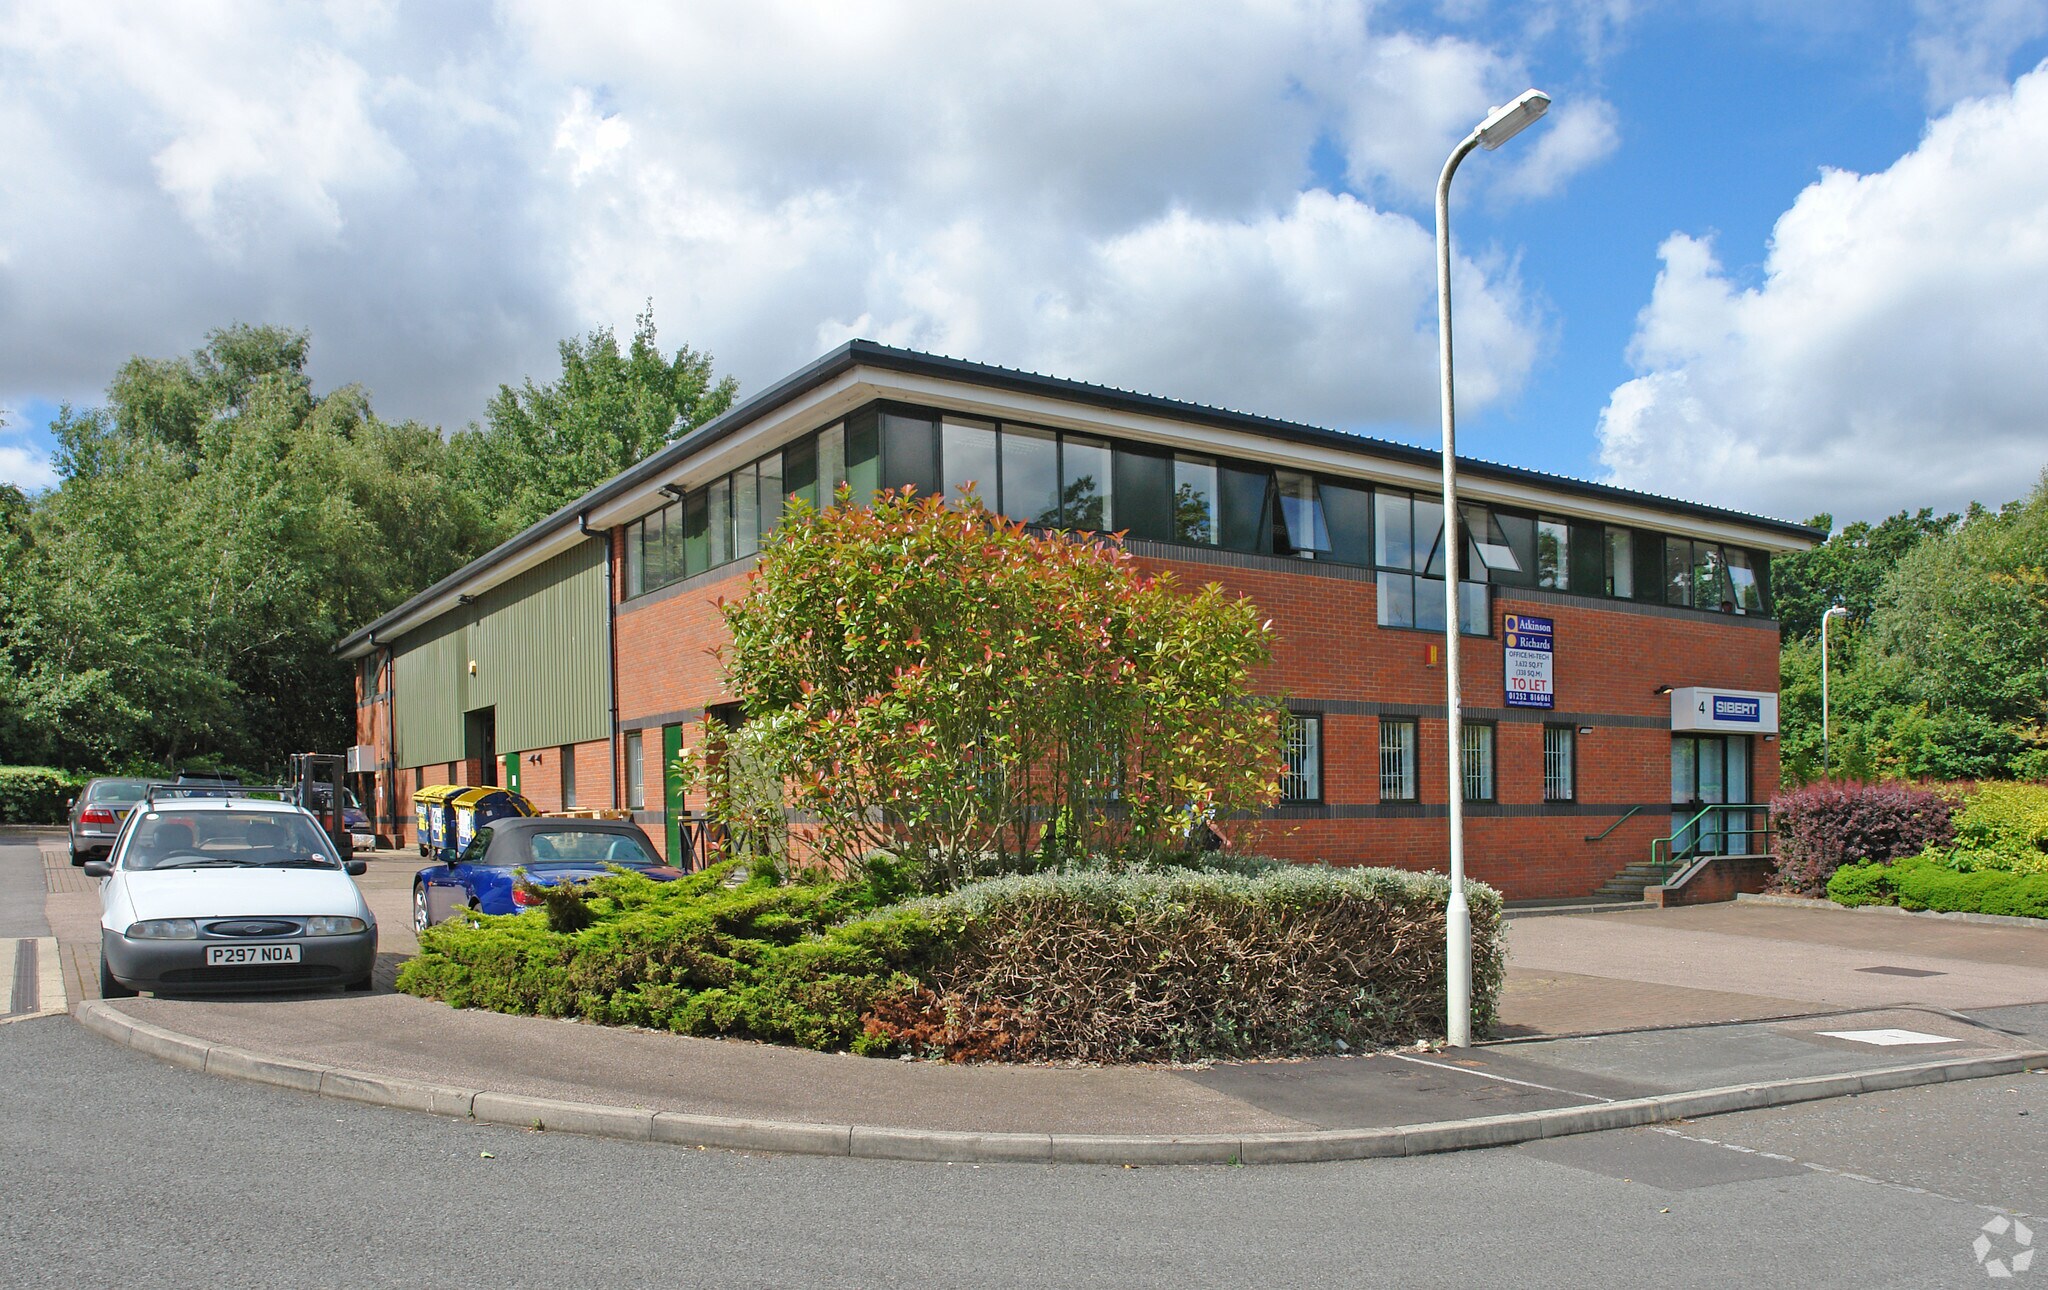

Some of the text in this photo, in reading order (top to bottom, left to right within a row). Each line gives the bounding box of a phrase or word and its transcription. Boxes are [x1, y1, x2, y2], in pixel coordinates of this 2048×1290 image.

[1519, 620, 1551, 632] Atkinson
[1520, 637, 1550, 650] Richards
[1512, 678, 1547, 691] TO LET
[1530, 693, 1550, 702] 816061
[1698, 701, 1705, 714] 4
[1716, 701, 1757, 715] SIBERT
[214, 948, 292, 962] P297 NOA
